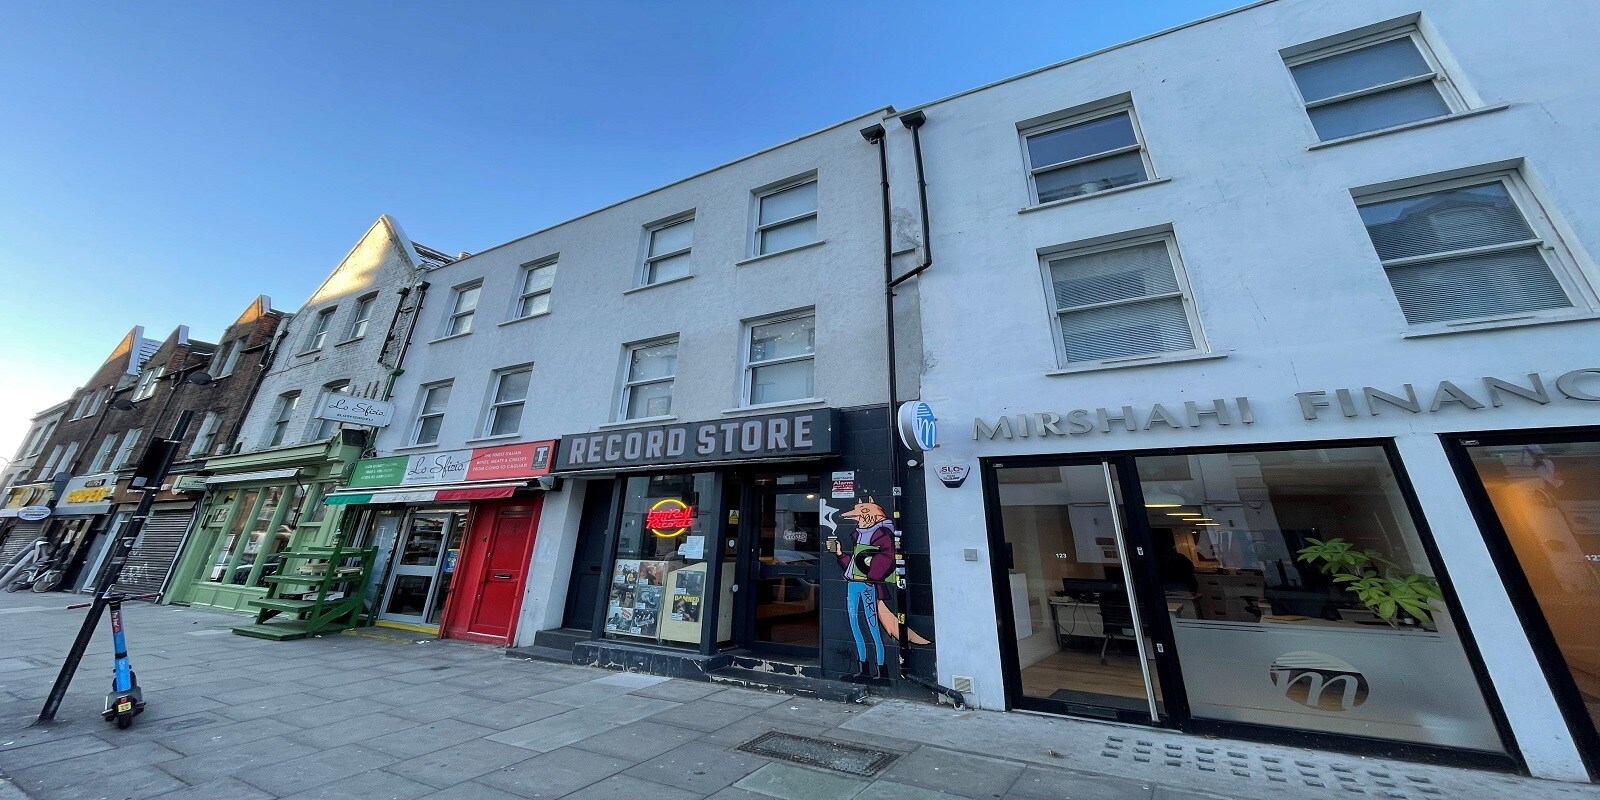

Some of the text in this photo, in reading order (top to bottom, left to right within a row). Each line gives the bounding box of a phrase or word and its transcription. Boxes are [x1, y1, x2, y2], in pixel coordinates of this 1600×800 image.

[328, 398, 349, 411] Lo
[972, 396, 1255, 441] MIRSHAHI
[568, 414, 814, 466] RECORD STORE
[407, 455, 427, 476] Lo
